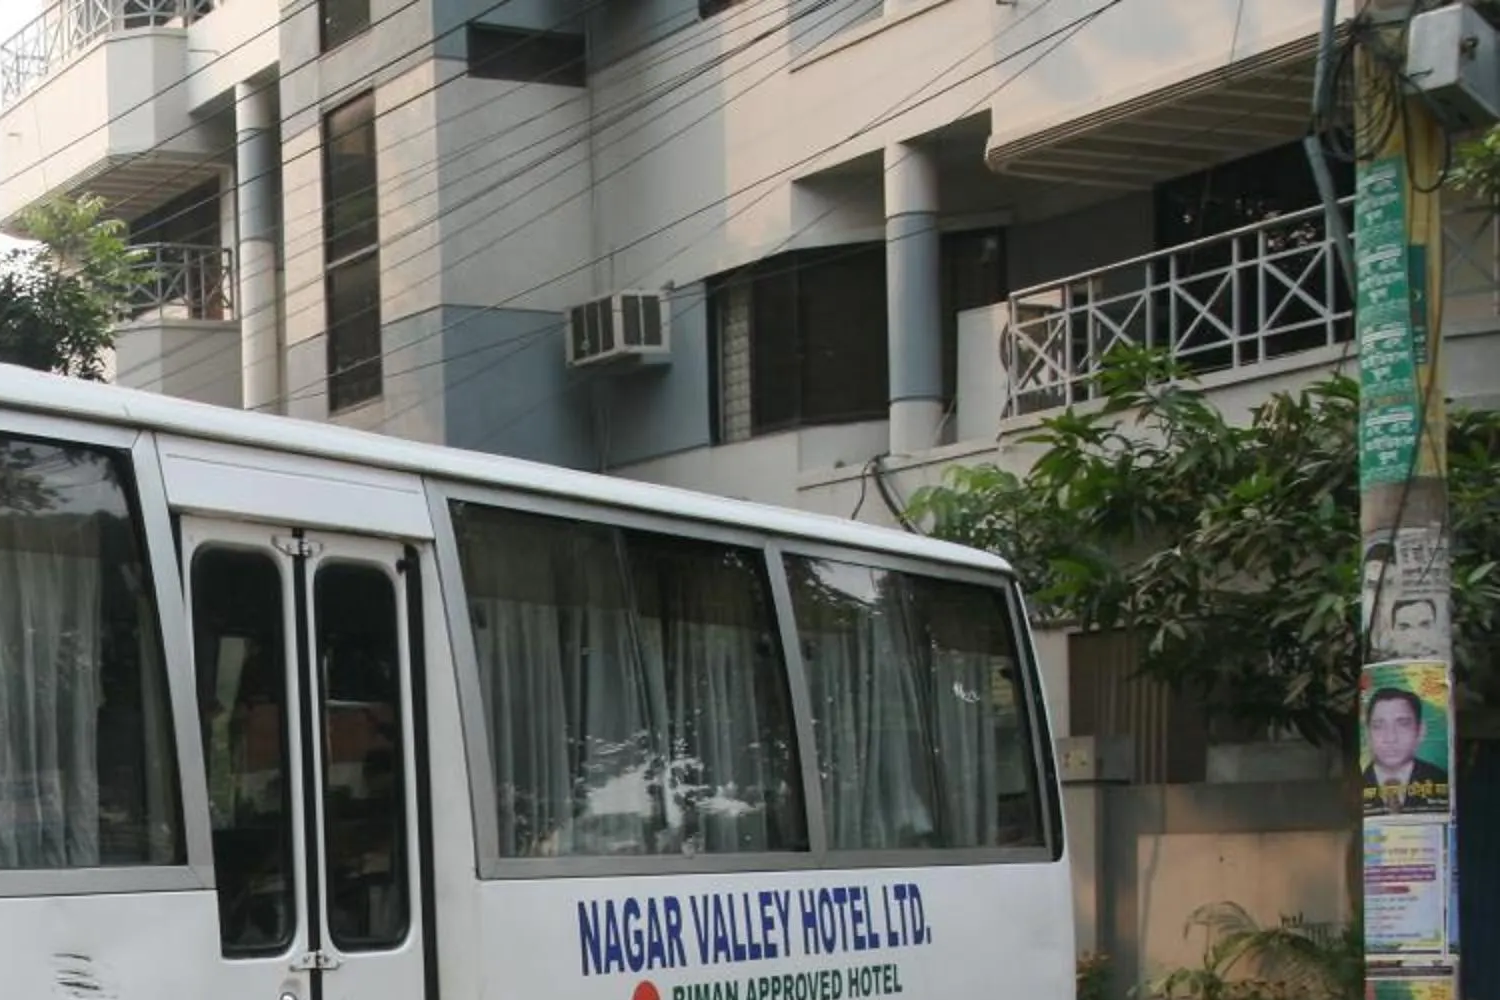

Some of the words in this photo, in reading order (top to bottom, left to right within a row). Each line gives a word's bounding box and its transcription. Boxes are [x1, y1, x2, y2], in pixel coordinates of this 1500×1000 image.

[577, 894, 687, 976] NAGAR
[690, 889, 792, 966] VALLEY
[798, 884, 880, 955] HOTEL
[882, 882, 932, 951] LTD.
[846, 963, 903, 1000] HOTEL
